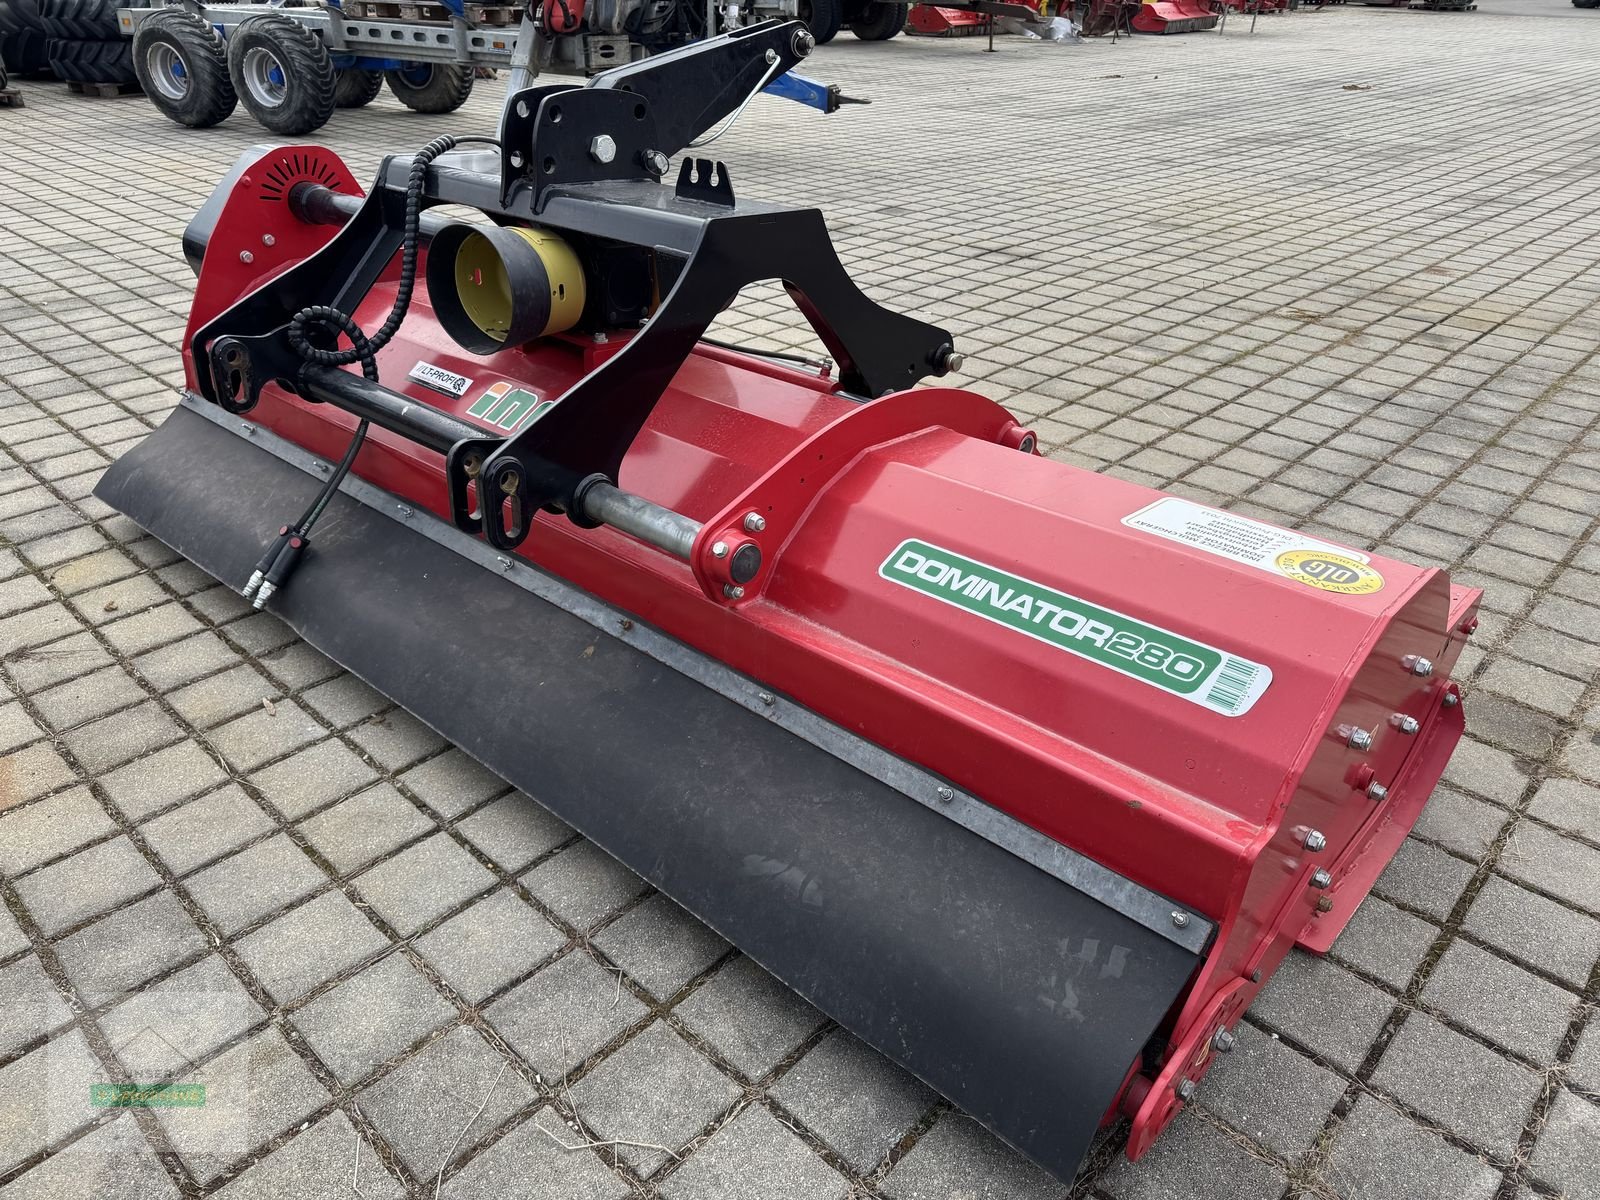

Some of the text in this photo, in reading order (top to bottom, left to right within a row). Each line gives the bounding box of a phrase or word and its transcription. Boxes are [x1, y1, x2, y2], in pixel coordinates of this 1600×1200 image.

[1205, 537, 1265, 558] DOMINATOR
[1241, 554, 1261, 562] INO
[1289, 571, 1375, 593] ANERKANNT
[1305, 561, 1353, 582] DLG
